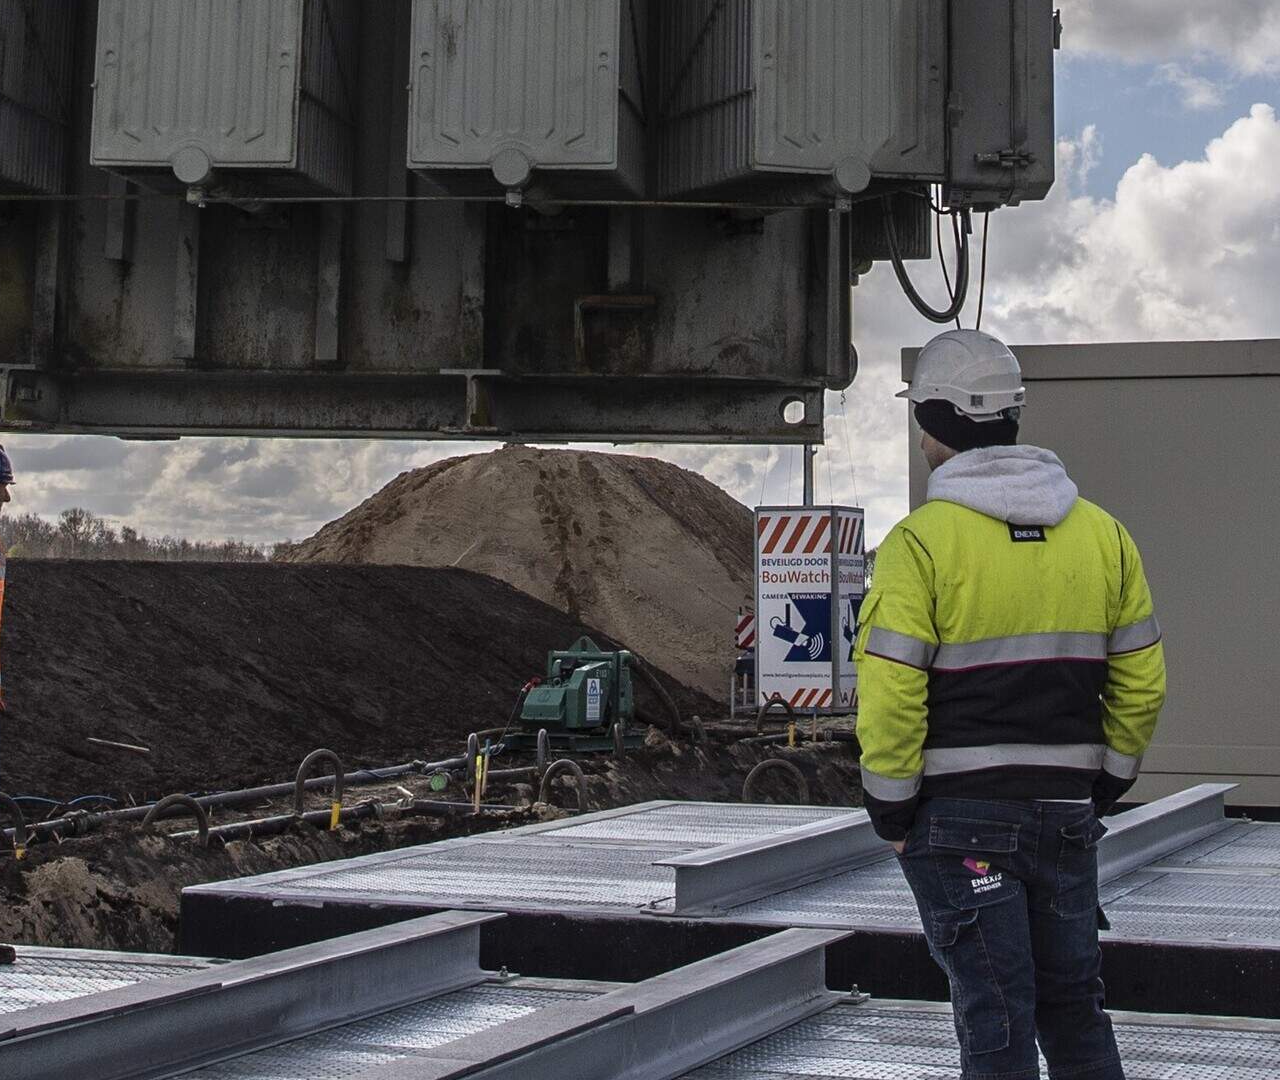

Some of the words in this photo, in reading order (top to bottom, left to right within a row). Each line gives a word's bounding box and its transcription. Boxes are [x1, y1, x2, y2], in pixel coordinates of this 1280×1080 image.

[762, 558, 803, 566] BEVEILIGD
[804, 558, 828, 566] DOOR
[762, 570, 829, 583] BouWatch
[971, 873, 1003, 887] ENEXIS
